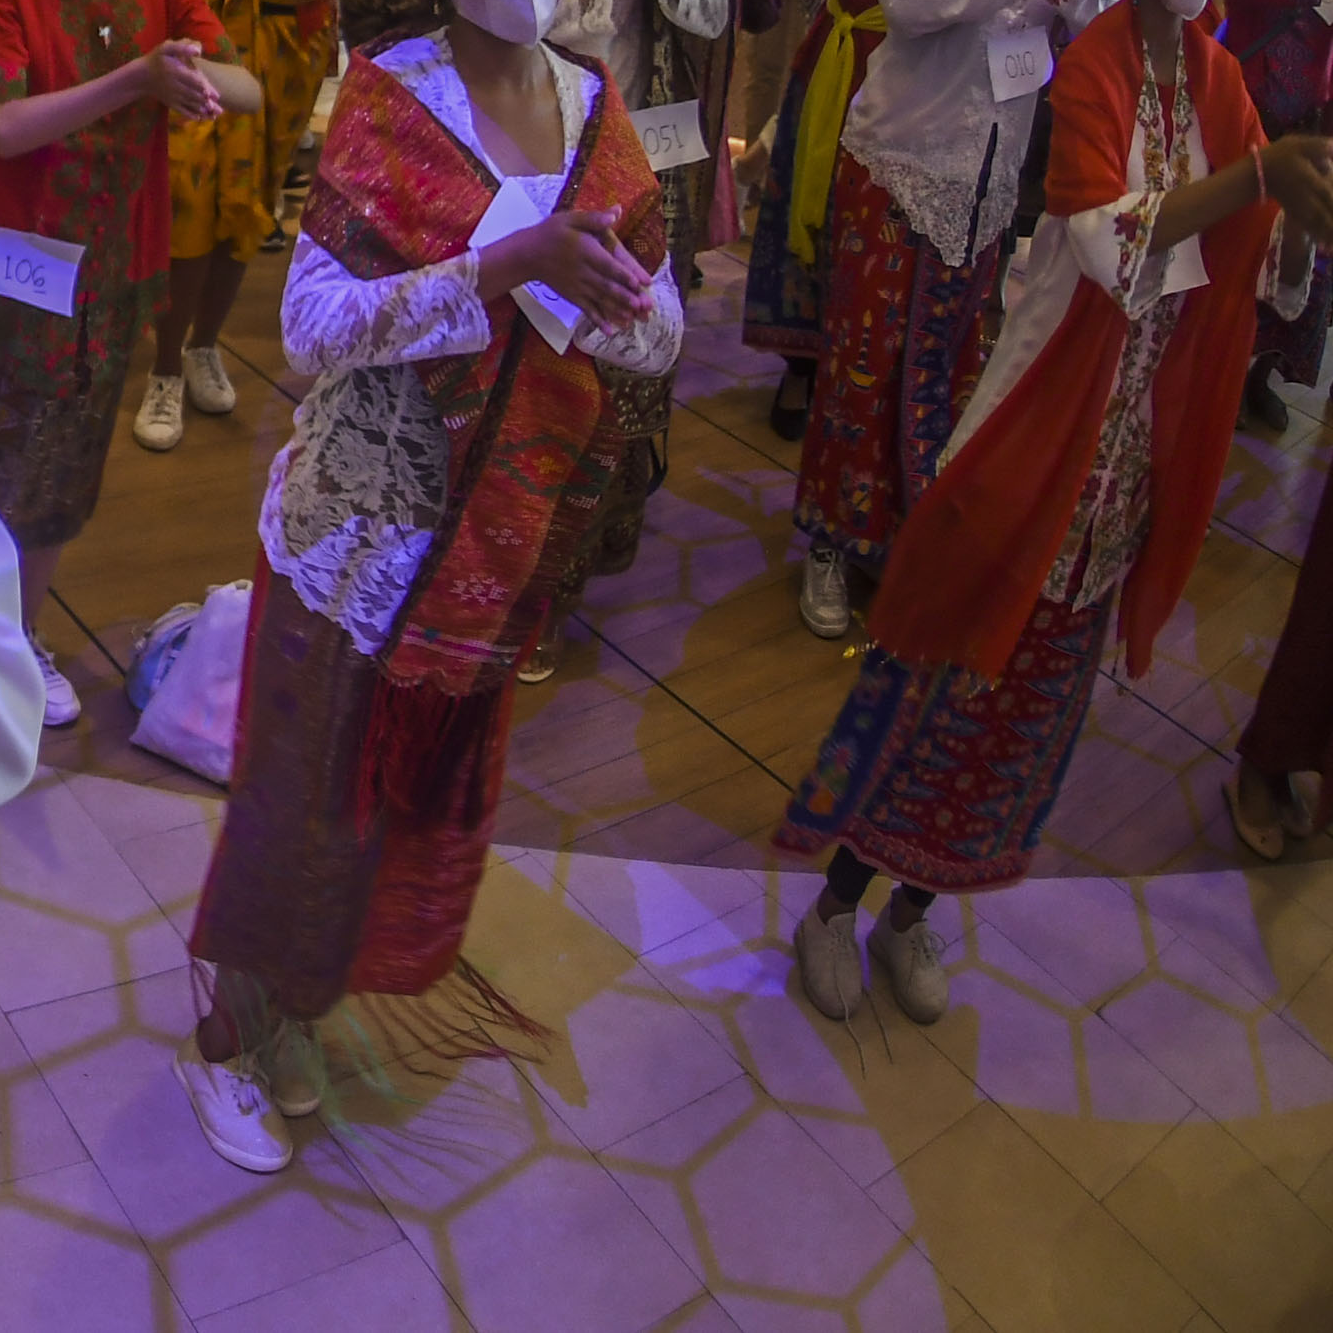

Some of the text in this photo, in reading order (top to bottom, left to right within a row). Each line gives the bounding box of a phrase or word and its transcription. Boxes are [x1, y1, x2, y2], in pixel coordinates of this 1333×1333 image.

[1005, 51, 1034, 78] 010
[643, 124, 684, 155] 051
[4, 255, 46, 290] 106
